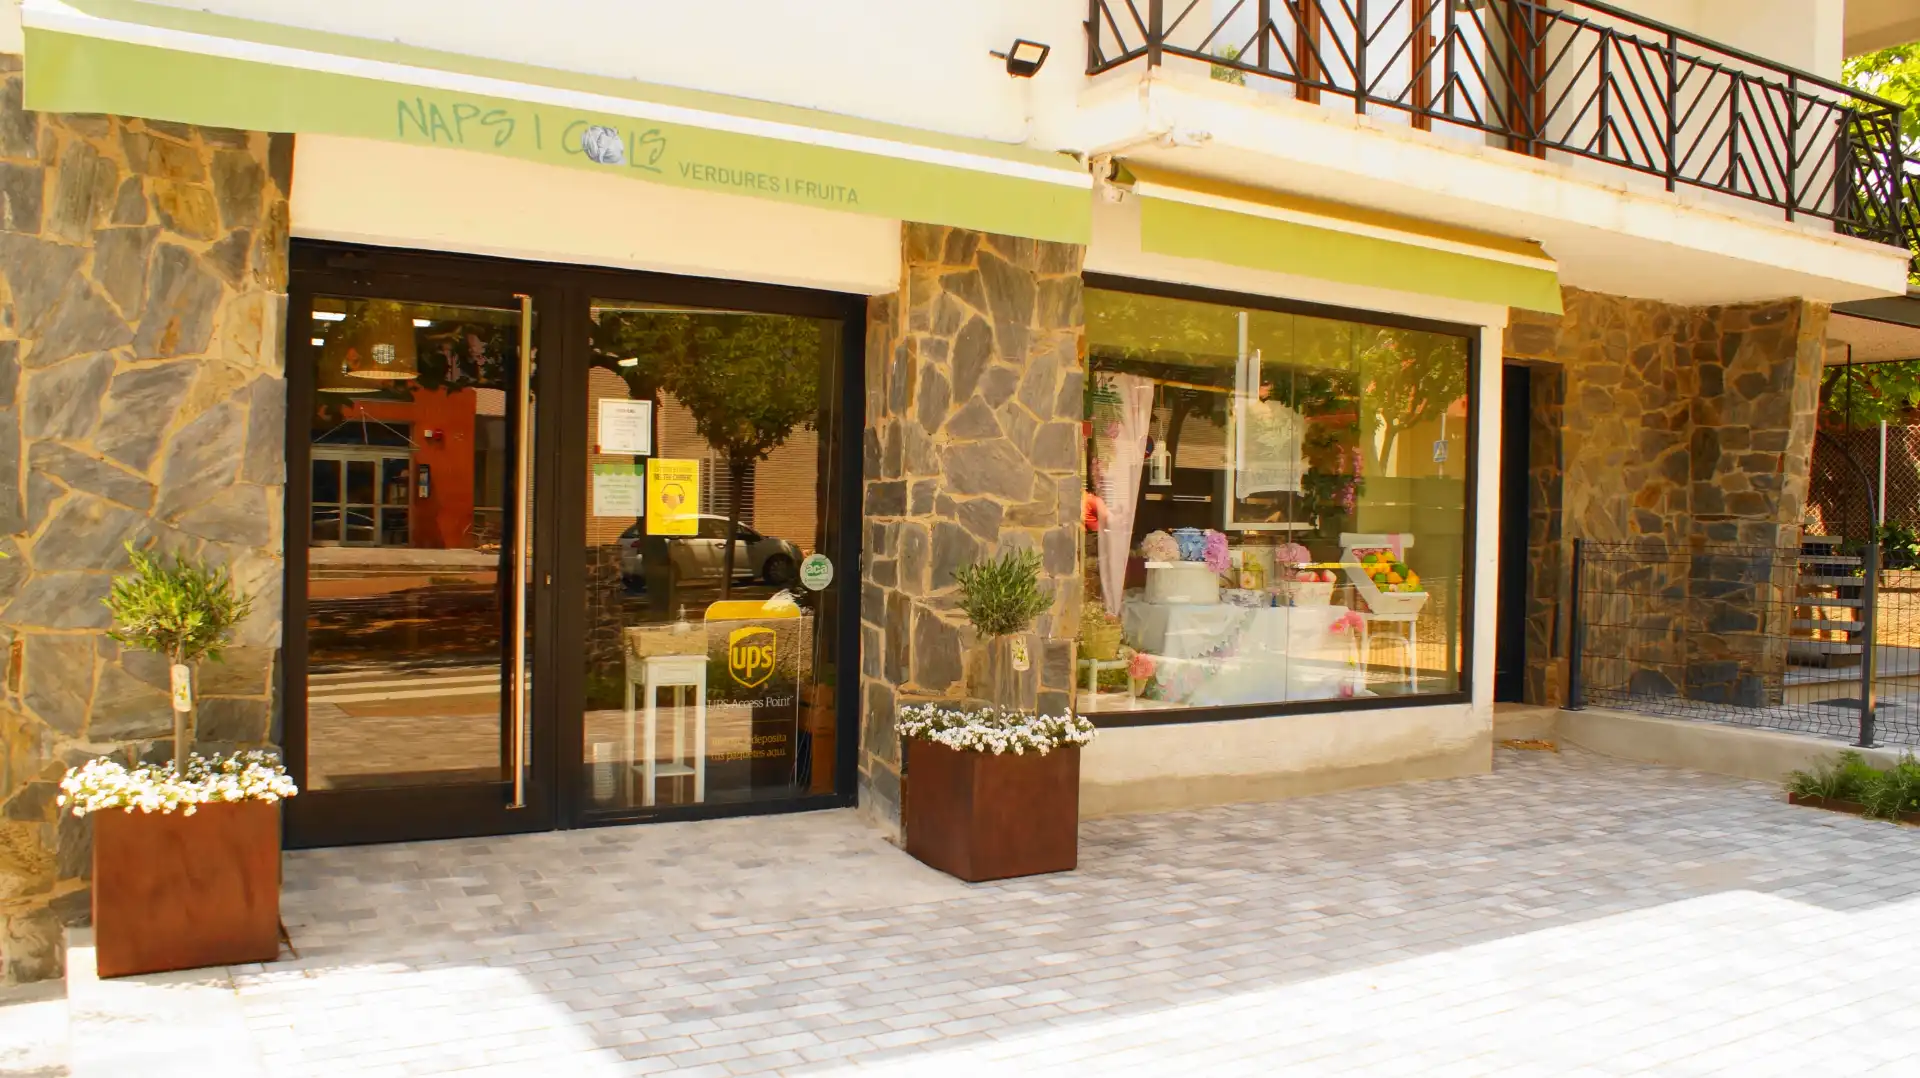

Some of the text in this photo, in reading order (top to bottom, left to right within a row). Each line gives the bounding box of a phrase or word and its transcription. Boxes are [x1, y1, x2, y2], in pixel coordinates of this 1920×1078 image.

[397, 96, 515, 147] NAPS
[534, 112, 542, 150] I
[678, 161, 859, 205] VERDURES I FRUITA
[707, 699, 729, 711] UPS
[732, 698, 764, 710] Access
[751, 734, 787, 746] deposita
